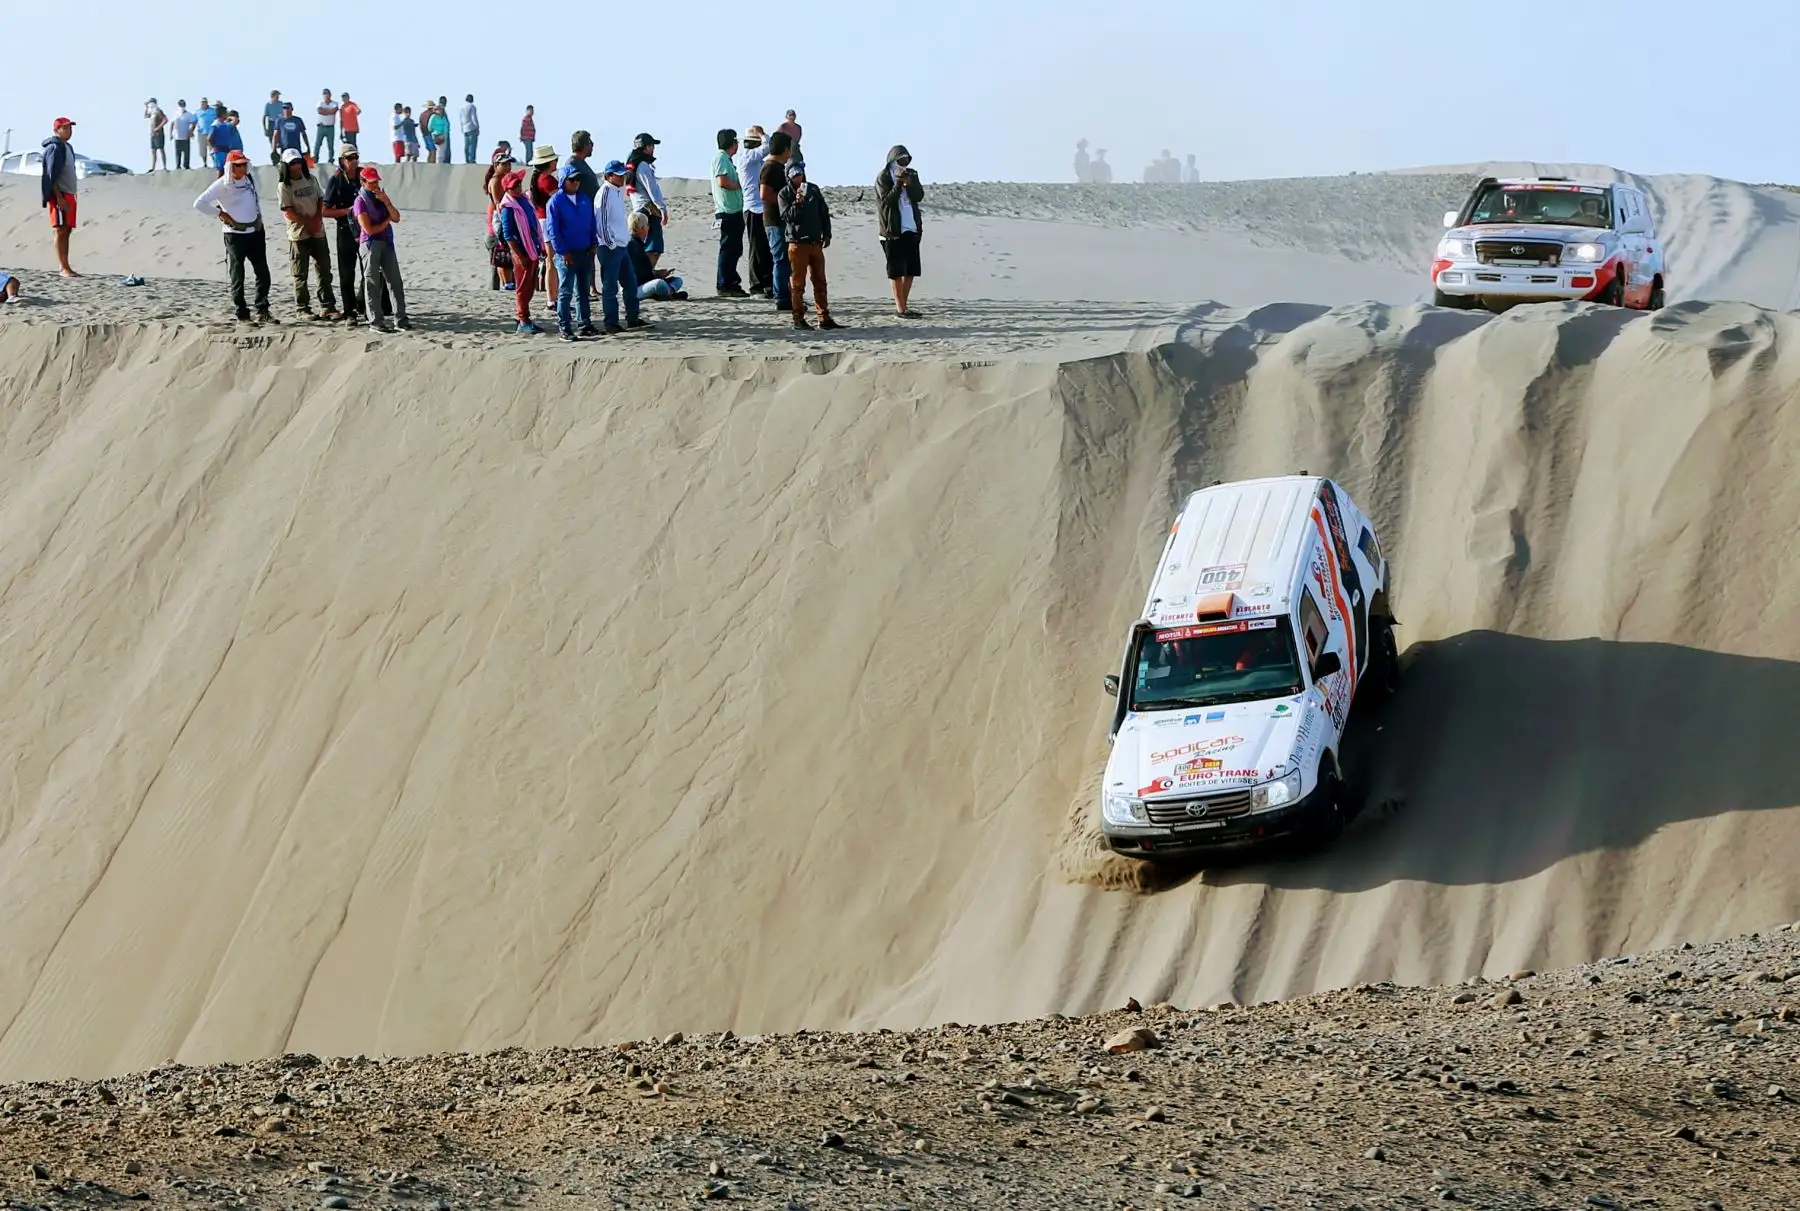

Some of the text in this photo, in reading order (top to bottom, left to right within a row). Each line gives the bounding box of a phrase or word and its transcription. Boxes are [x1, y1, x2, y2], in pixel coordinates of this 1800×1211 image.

[1202, 570, 1242, 584] 400
[1158, 631, 1182, 640] MOTUL
[1180, 768, 1259, 781] EURO-TRANS
